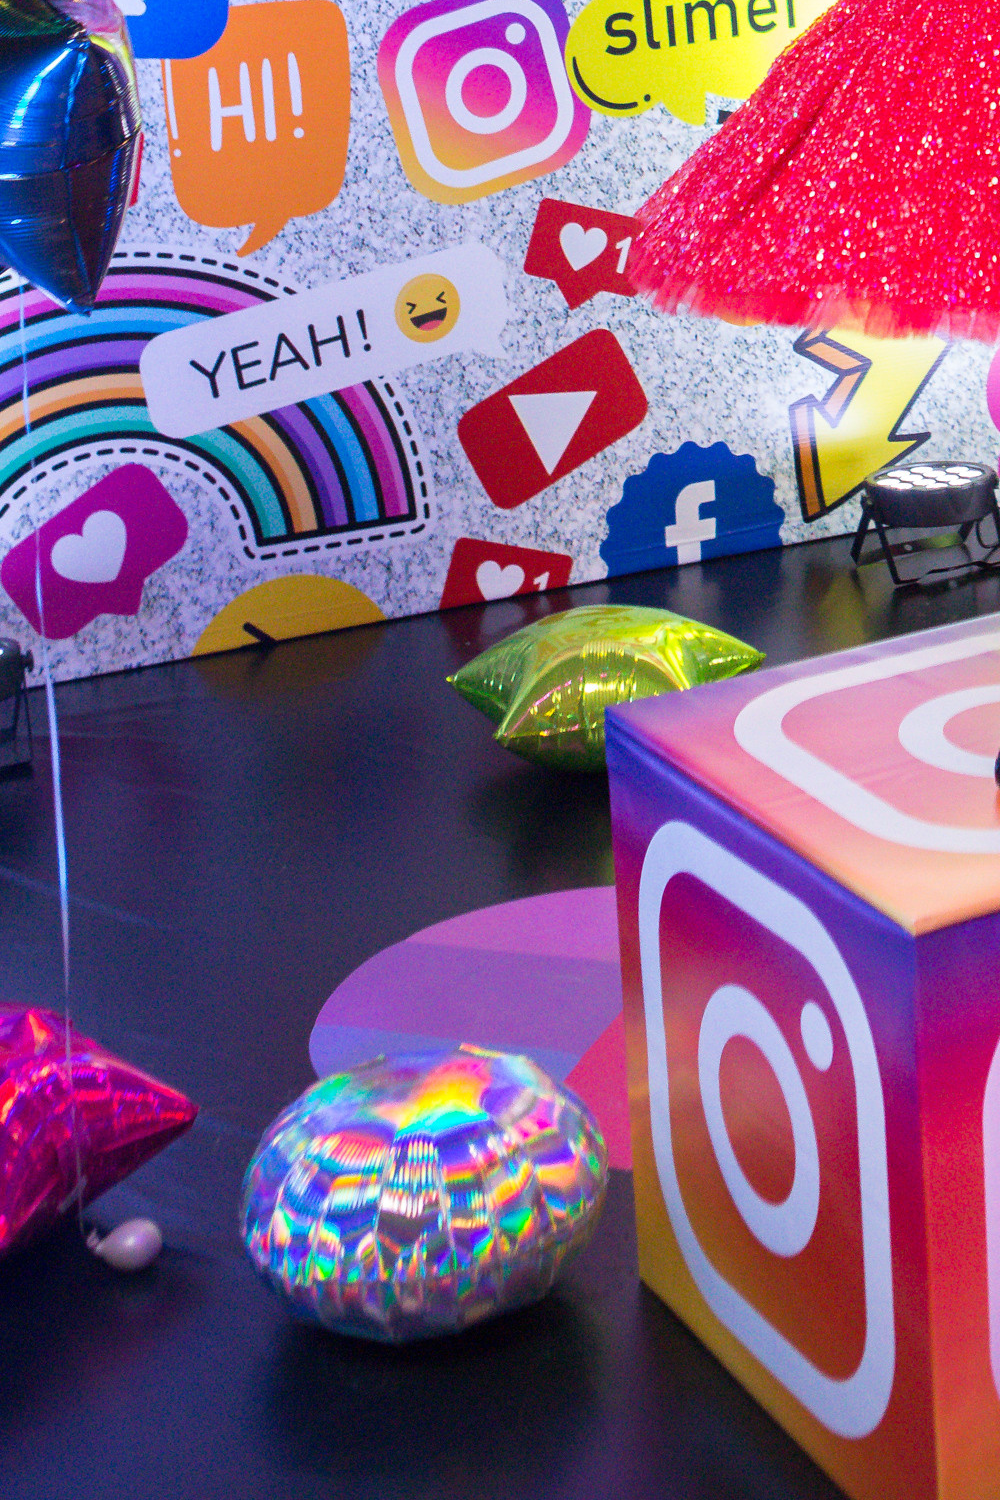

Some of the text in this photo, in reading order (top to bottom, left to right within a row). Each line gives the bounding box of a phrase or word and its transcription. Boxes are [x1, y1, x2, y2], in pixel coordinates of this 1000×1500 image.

[208, 51, 304, 152] HI!
[615, 236, 632, 274] 1
[189, 308, 372, 399] YEAH!
